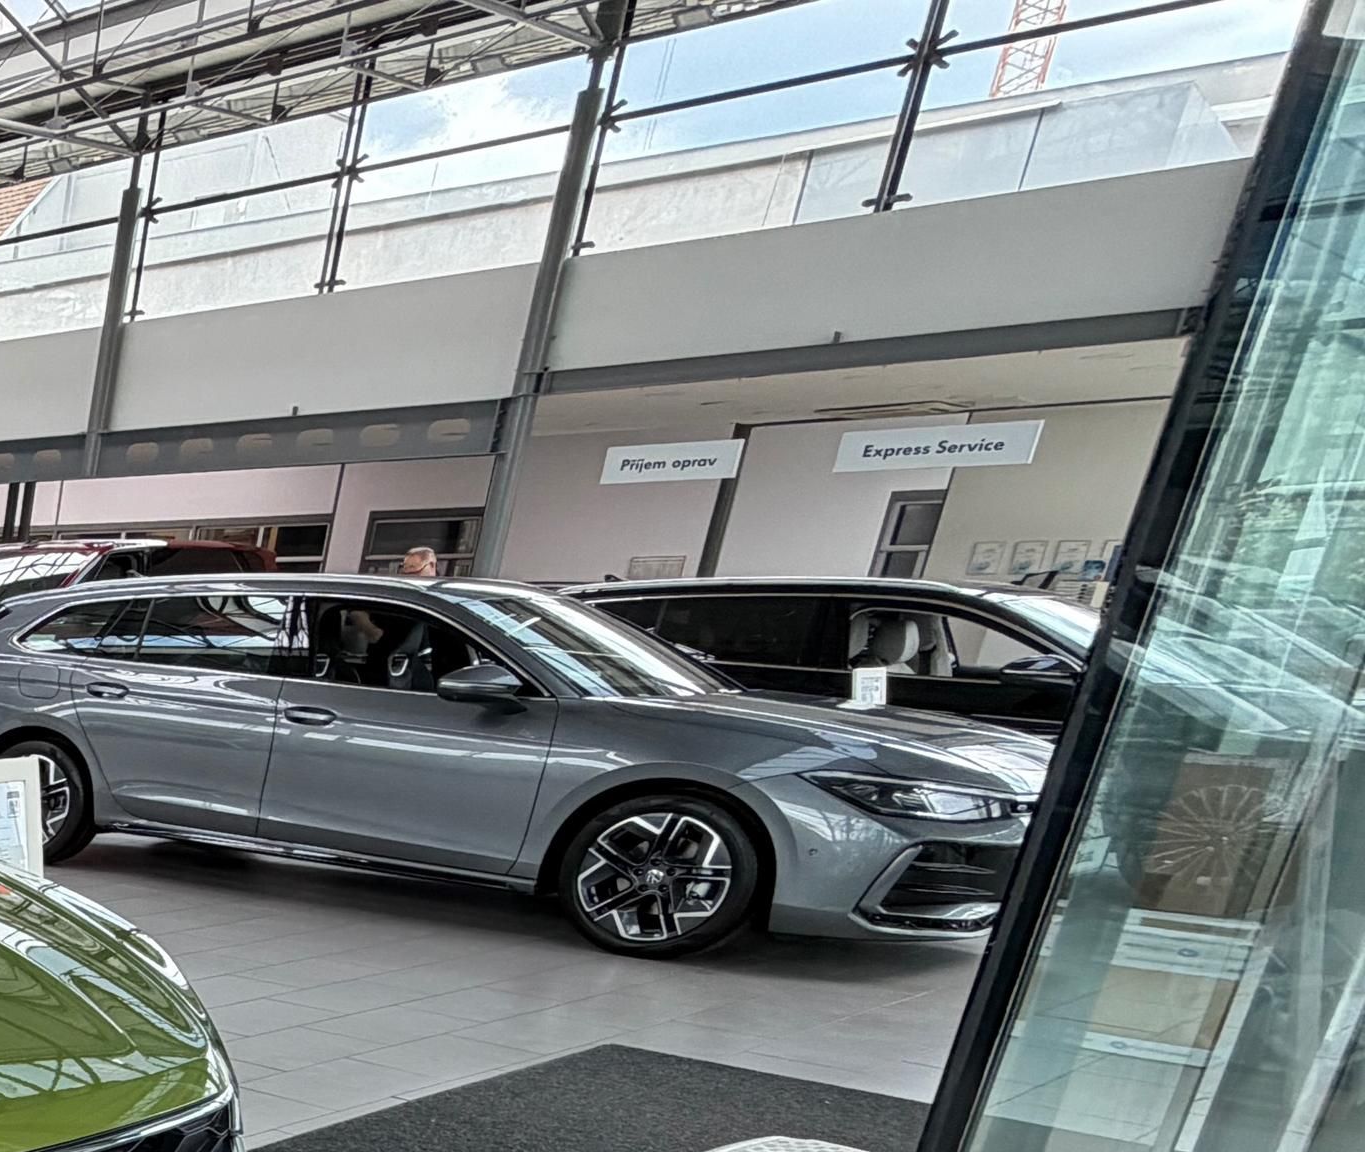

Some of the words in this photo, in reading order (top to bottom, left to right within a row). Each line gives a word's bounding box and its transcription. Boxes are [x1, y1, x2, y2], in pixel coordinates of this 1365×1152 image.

[862, 444, 931, 460] Express
[935, 438, 1005, 454] Service
[620, 458, 666, 473] Příjem
[671, 457, 717, 471] oprav
